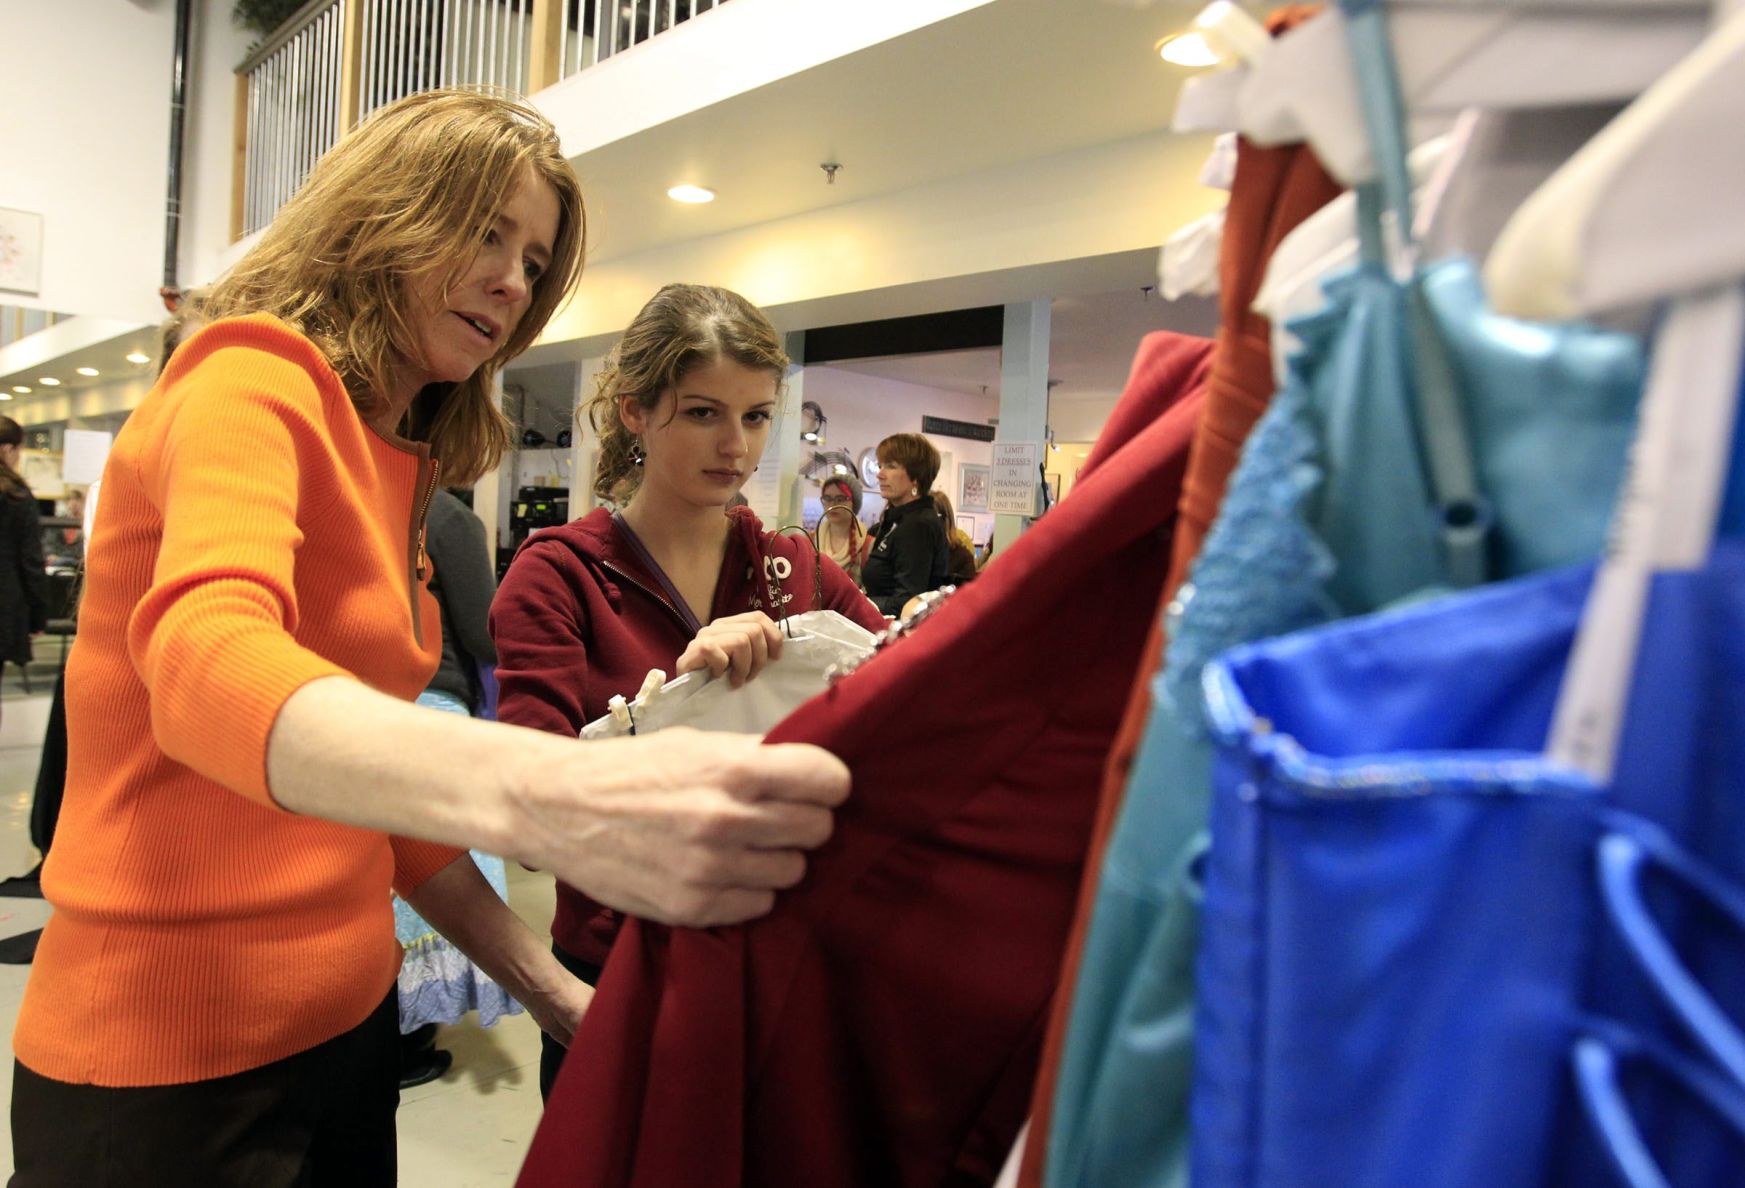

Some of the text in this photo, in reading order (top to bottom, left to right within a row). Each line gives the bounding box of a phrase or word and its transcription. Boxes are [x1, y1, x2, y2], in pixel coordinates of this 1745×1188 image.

[1004, 446, 1025, 454] LIMIT
[1009, 469, 1017, 477] IN
[993, 480, 1032, 488] CHANGING
[996, 490, 1027, 498] ROOM AT
[993, 500, 1026, 510] ONE TIME
